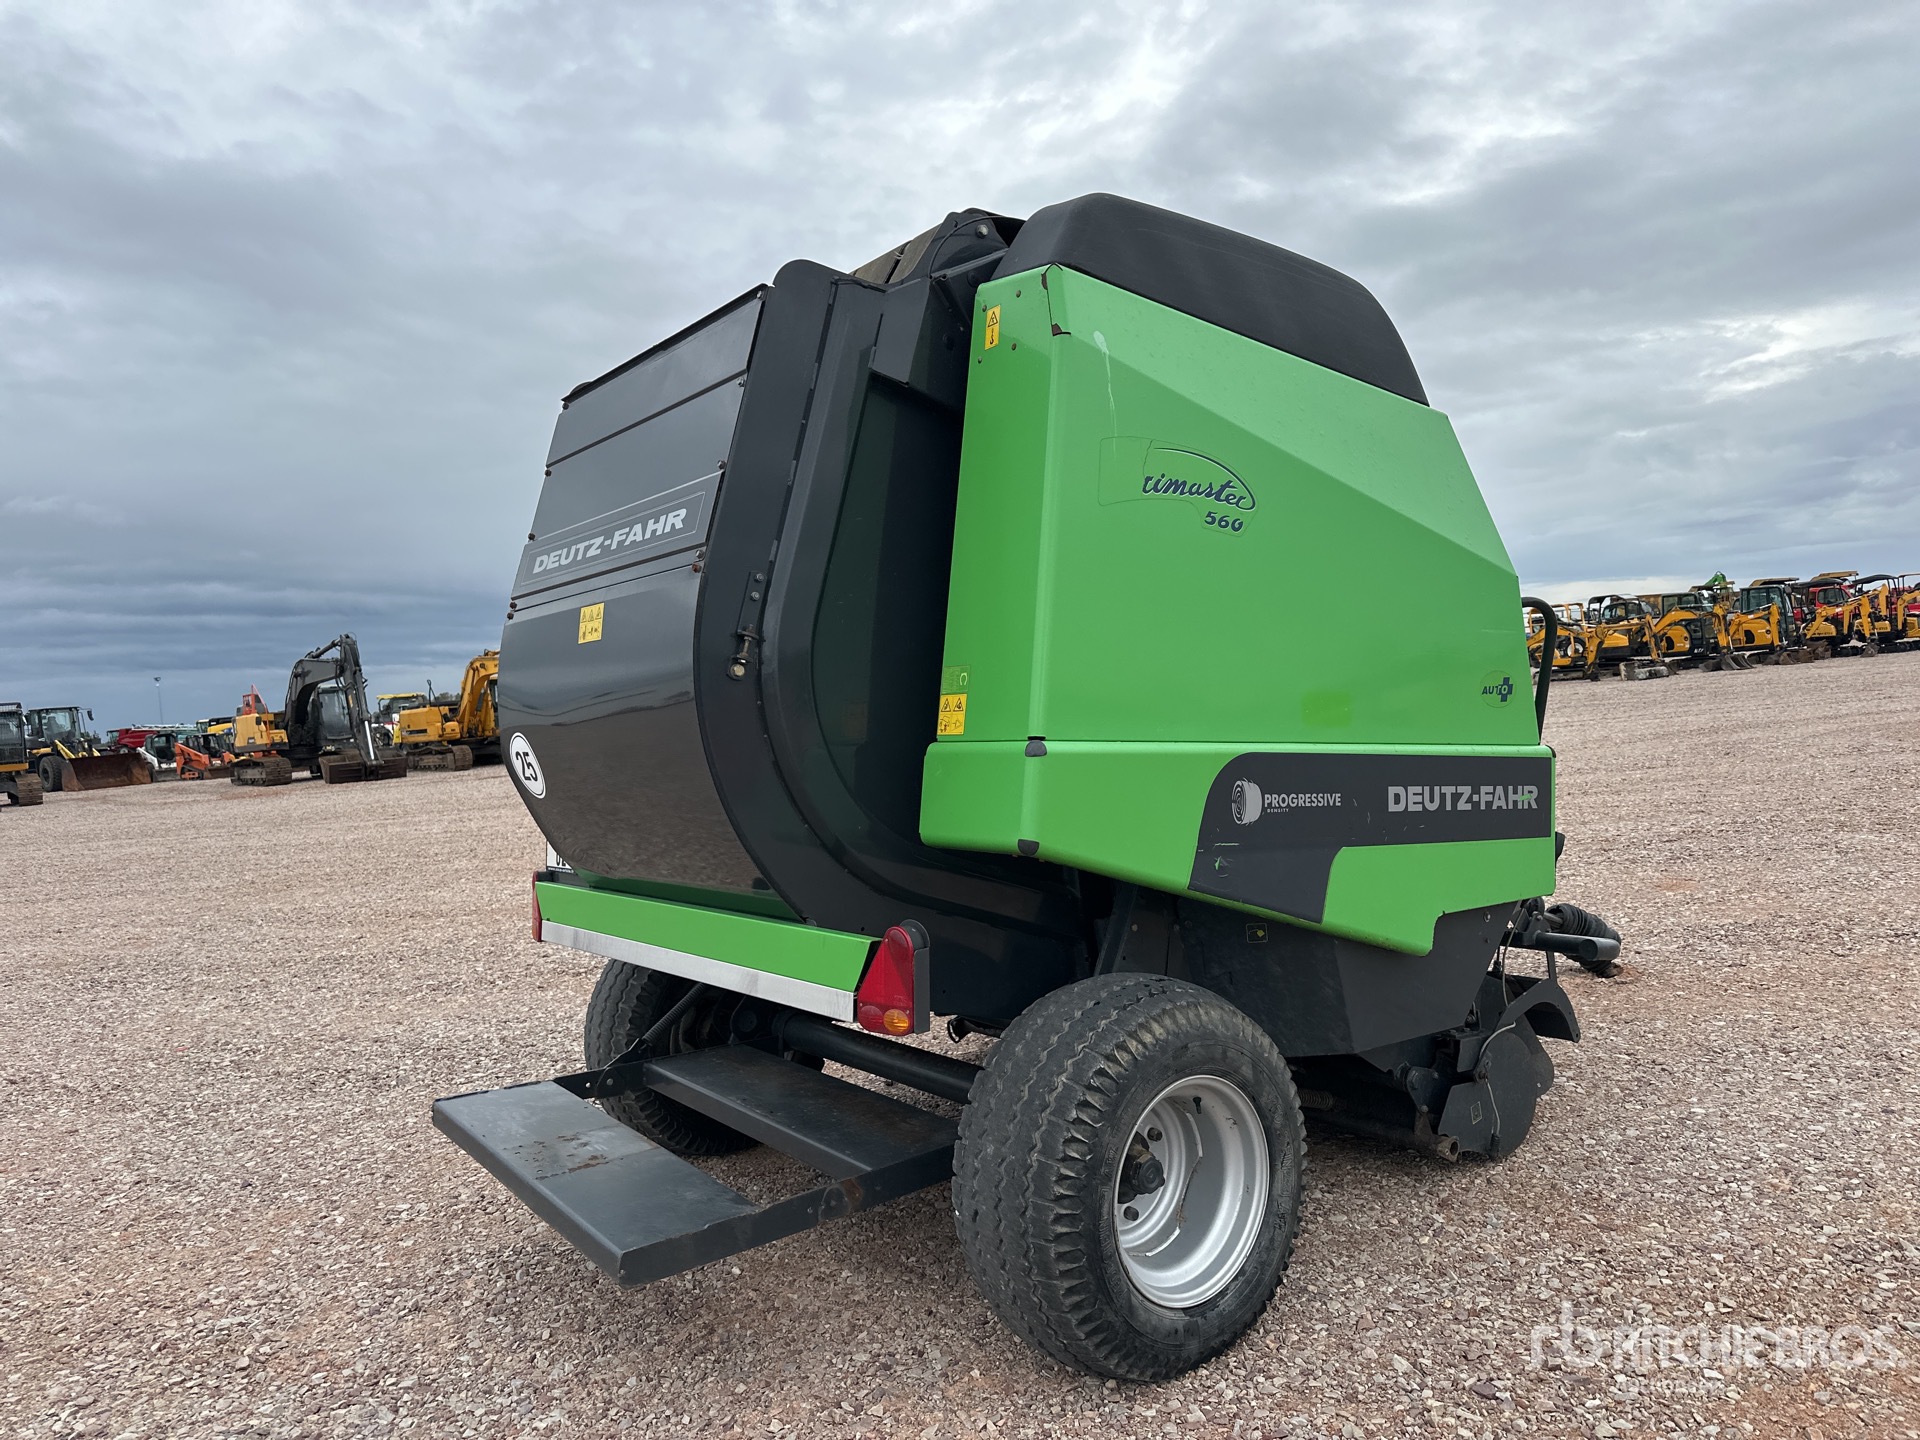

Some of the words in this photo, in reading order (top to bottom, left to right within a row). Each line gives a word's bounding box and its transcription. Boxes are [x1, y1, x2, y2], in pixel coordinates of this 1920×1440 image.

[1203, 510, 1244, 533] 560
[533, 508, 687, 574] DEUTZ-FAHR
[515, 750, 538, 782] 25
[1264, 793, 1342, 808] PROGRESSIVE
[1388, 785, 1538, 813] DEUTZ-FAHR
